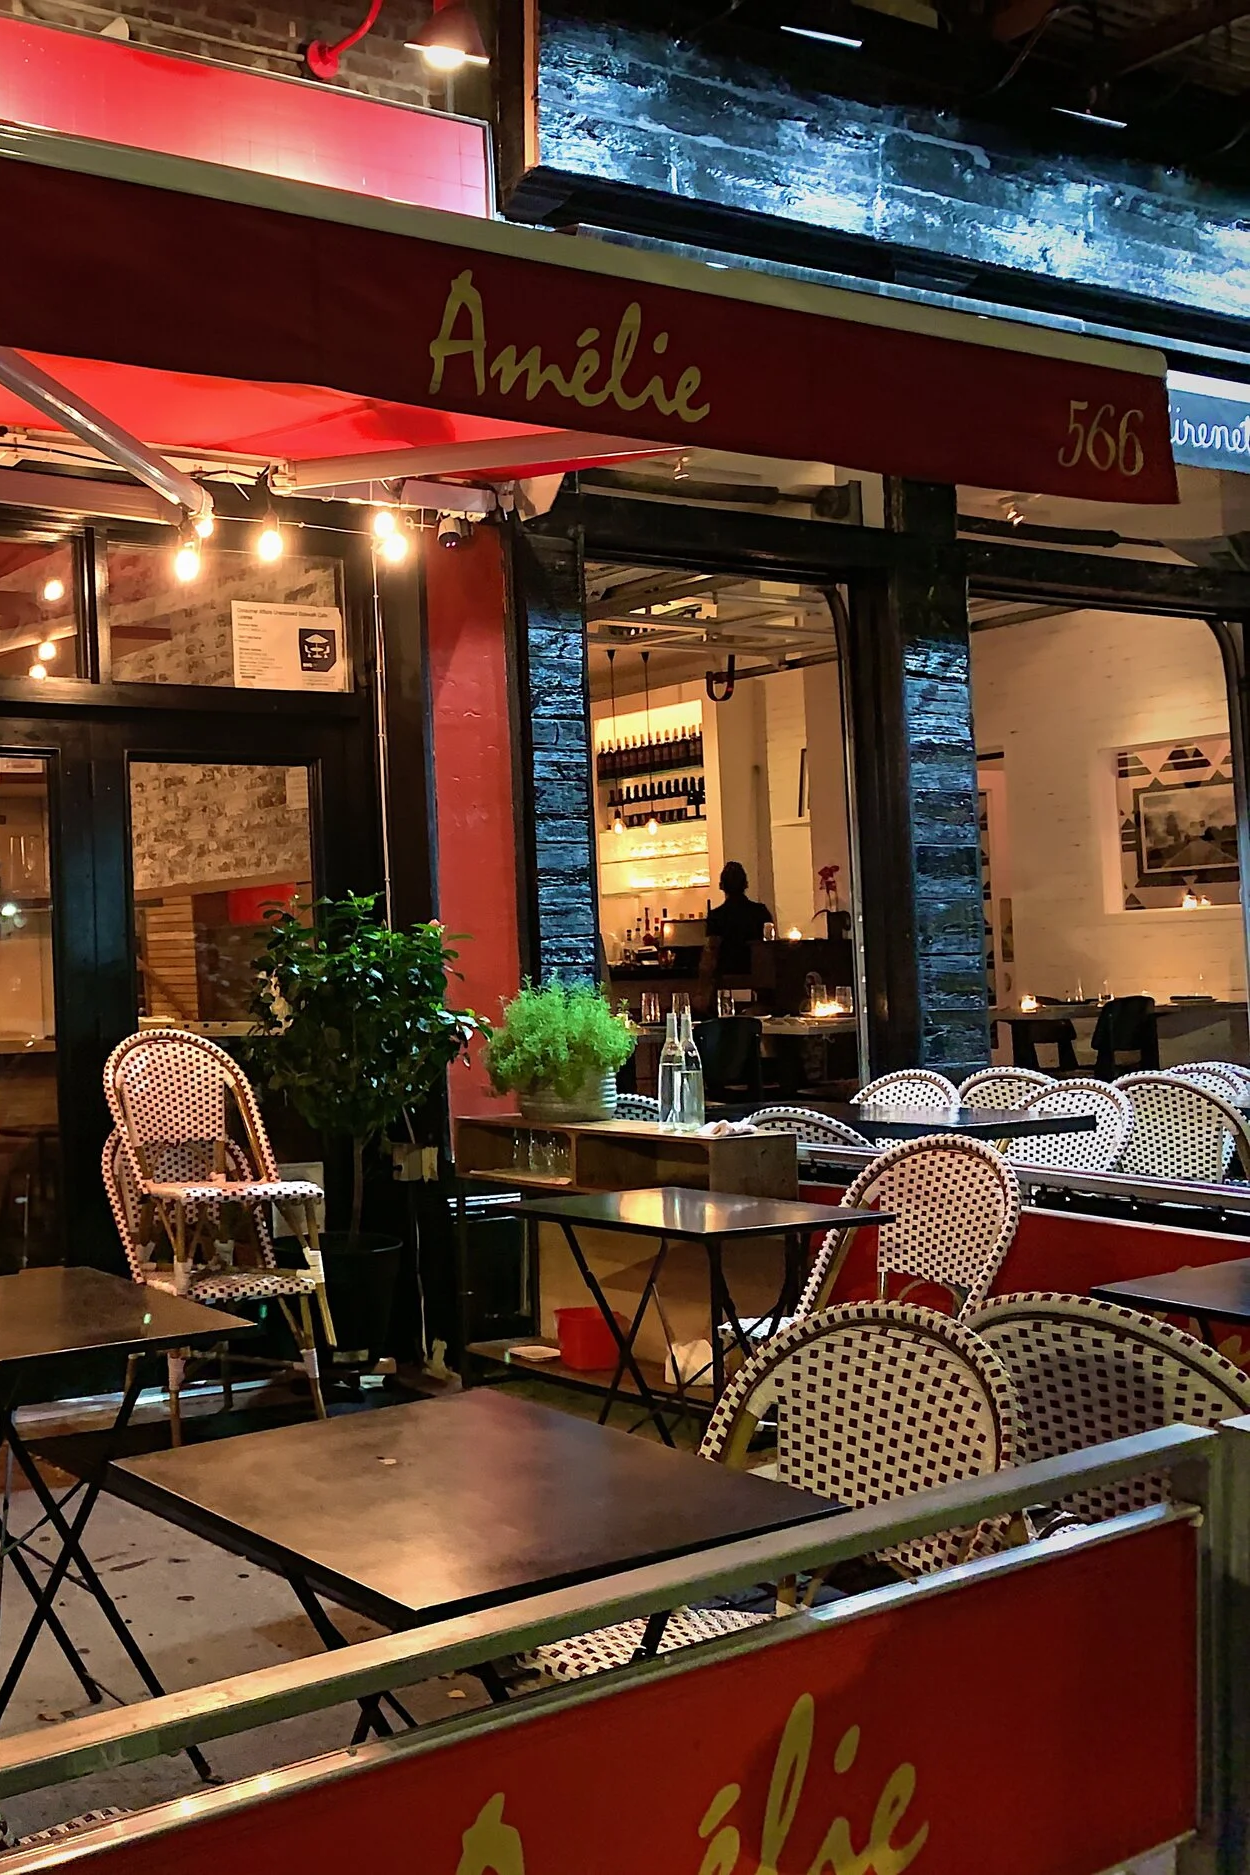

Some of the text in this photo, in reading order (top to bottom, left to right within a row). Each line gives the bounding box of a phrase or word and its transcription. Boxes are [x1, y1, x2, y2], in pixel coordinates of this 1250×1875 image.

[429, 269, 710, 423] Amélie
[1058, 400, 1144, 476] 566
[1168, 404, 1250, 457] irenet
[455, 1692, 929, 1875] élie
